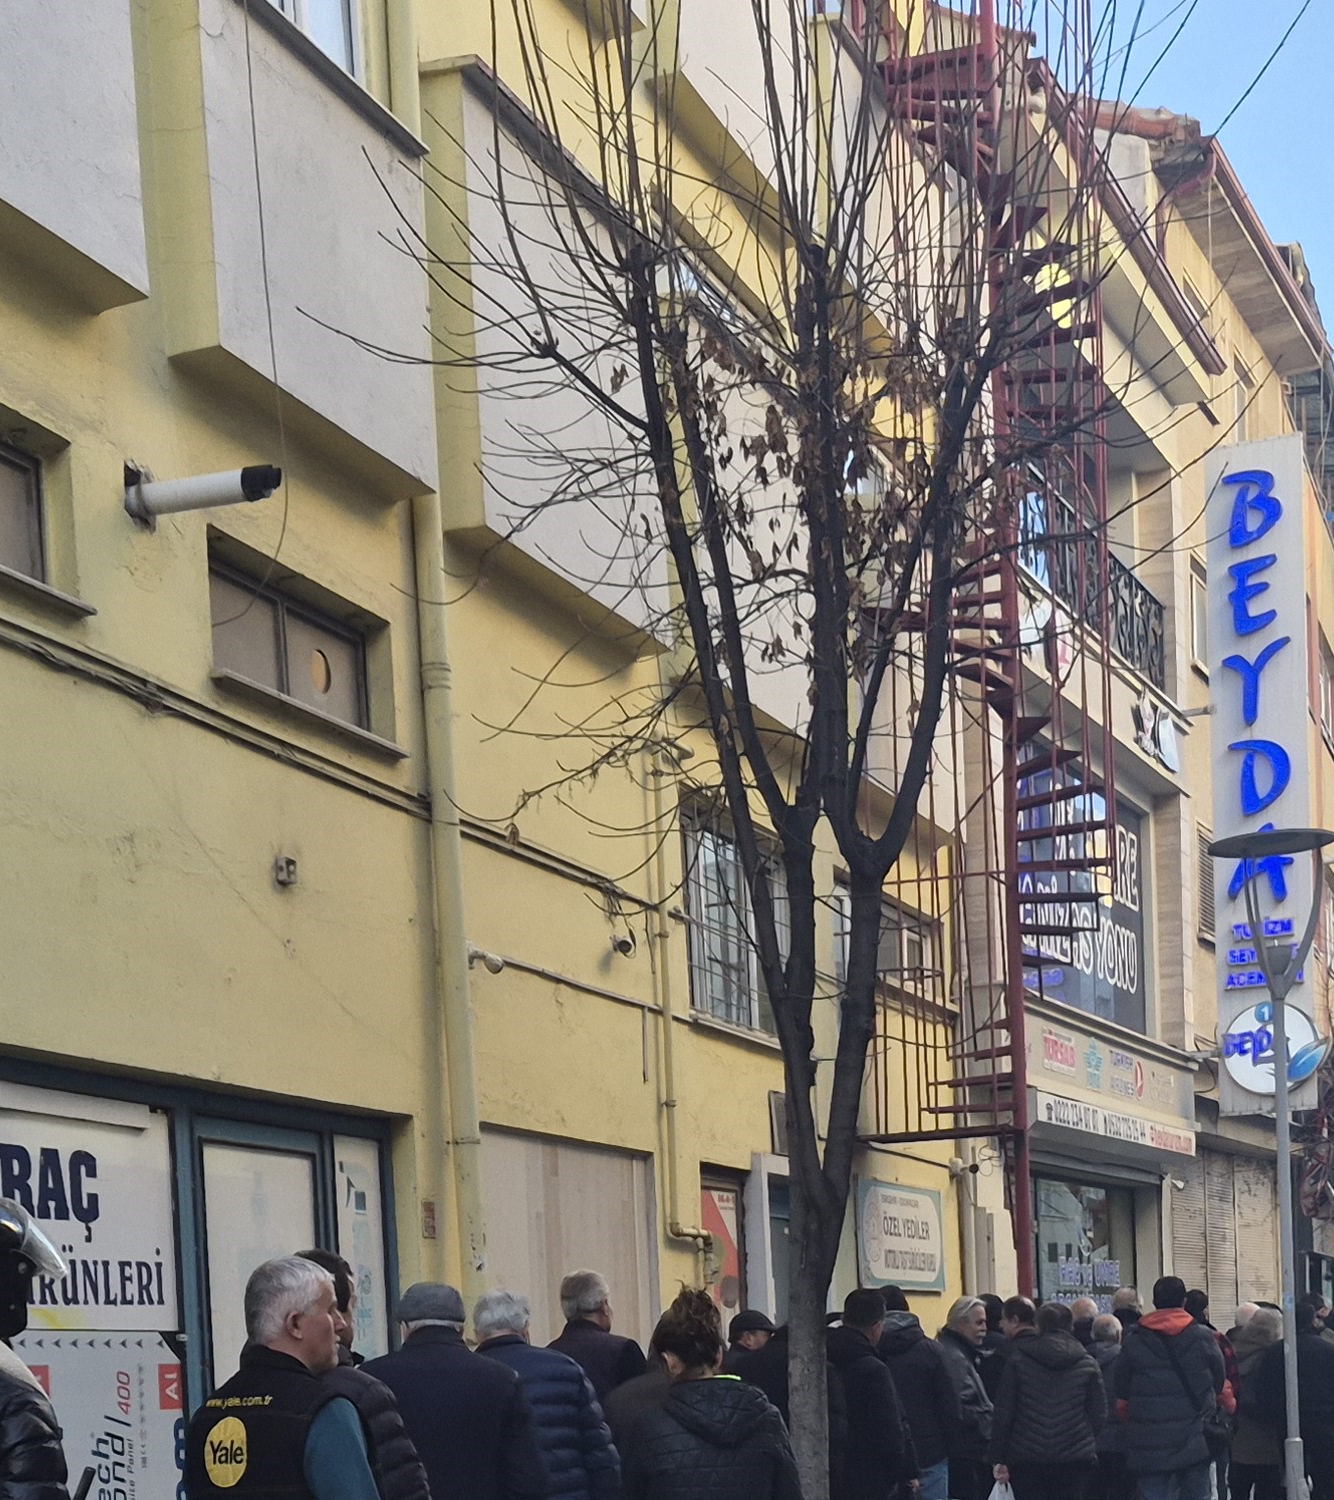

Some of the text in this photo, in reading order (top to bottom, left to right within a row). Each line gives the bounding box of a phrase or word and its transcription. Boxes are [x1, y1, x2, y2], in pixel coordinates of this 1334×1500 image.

[1221, 469, 1295, 902] BEYDA
[1233, 916, 1293, 940] TUİZM
[30, 1244, 166, 1306] RÜNLERİ
[116, 1371, 131, 1415] 400
[209, 1440, 245, 1466] Yale
